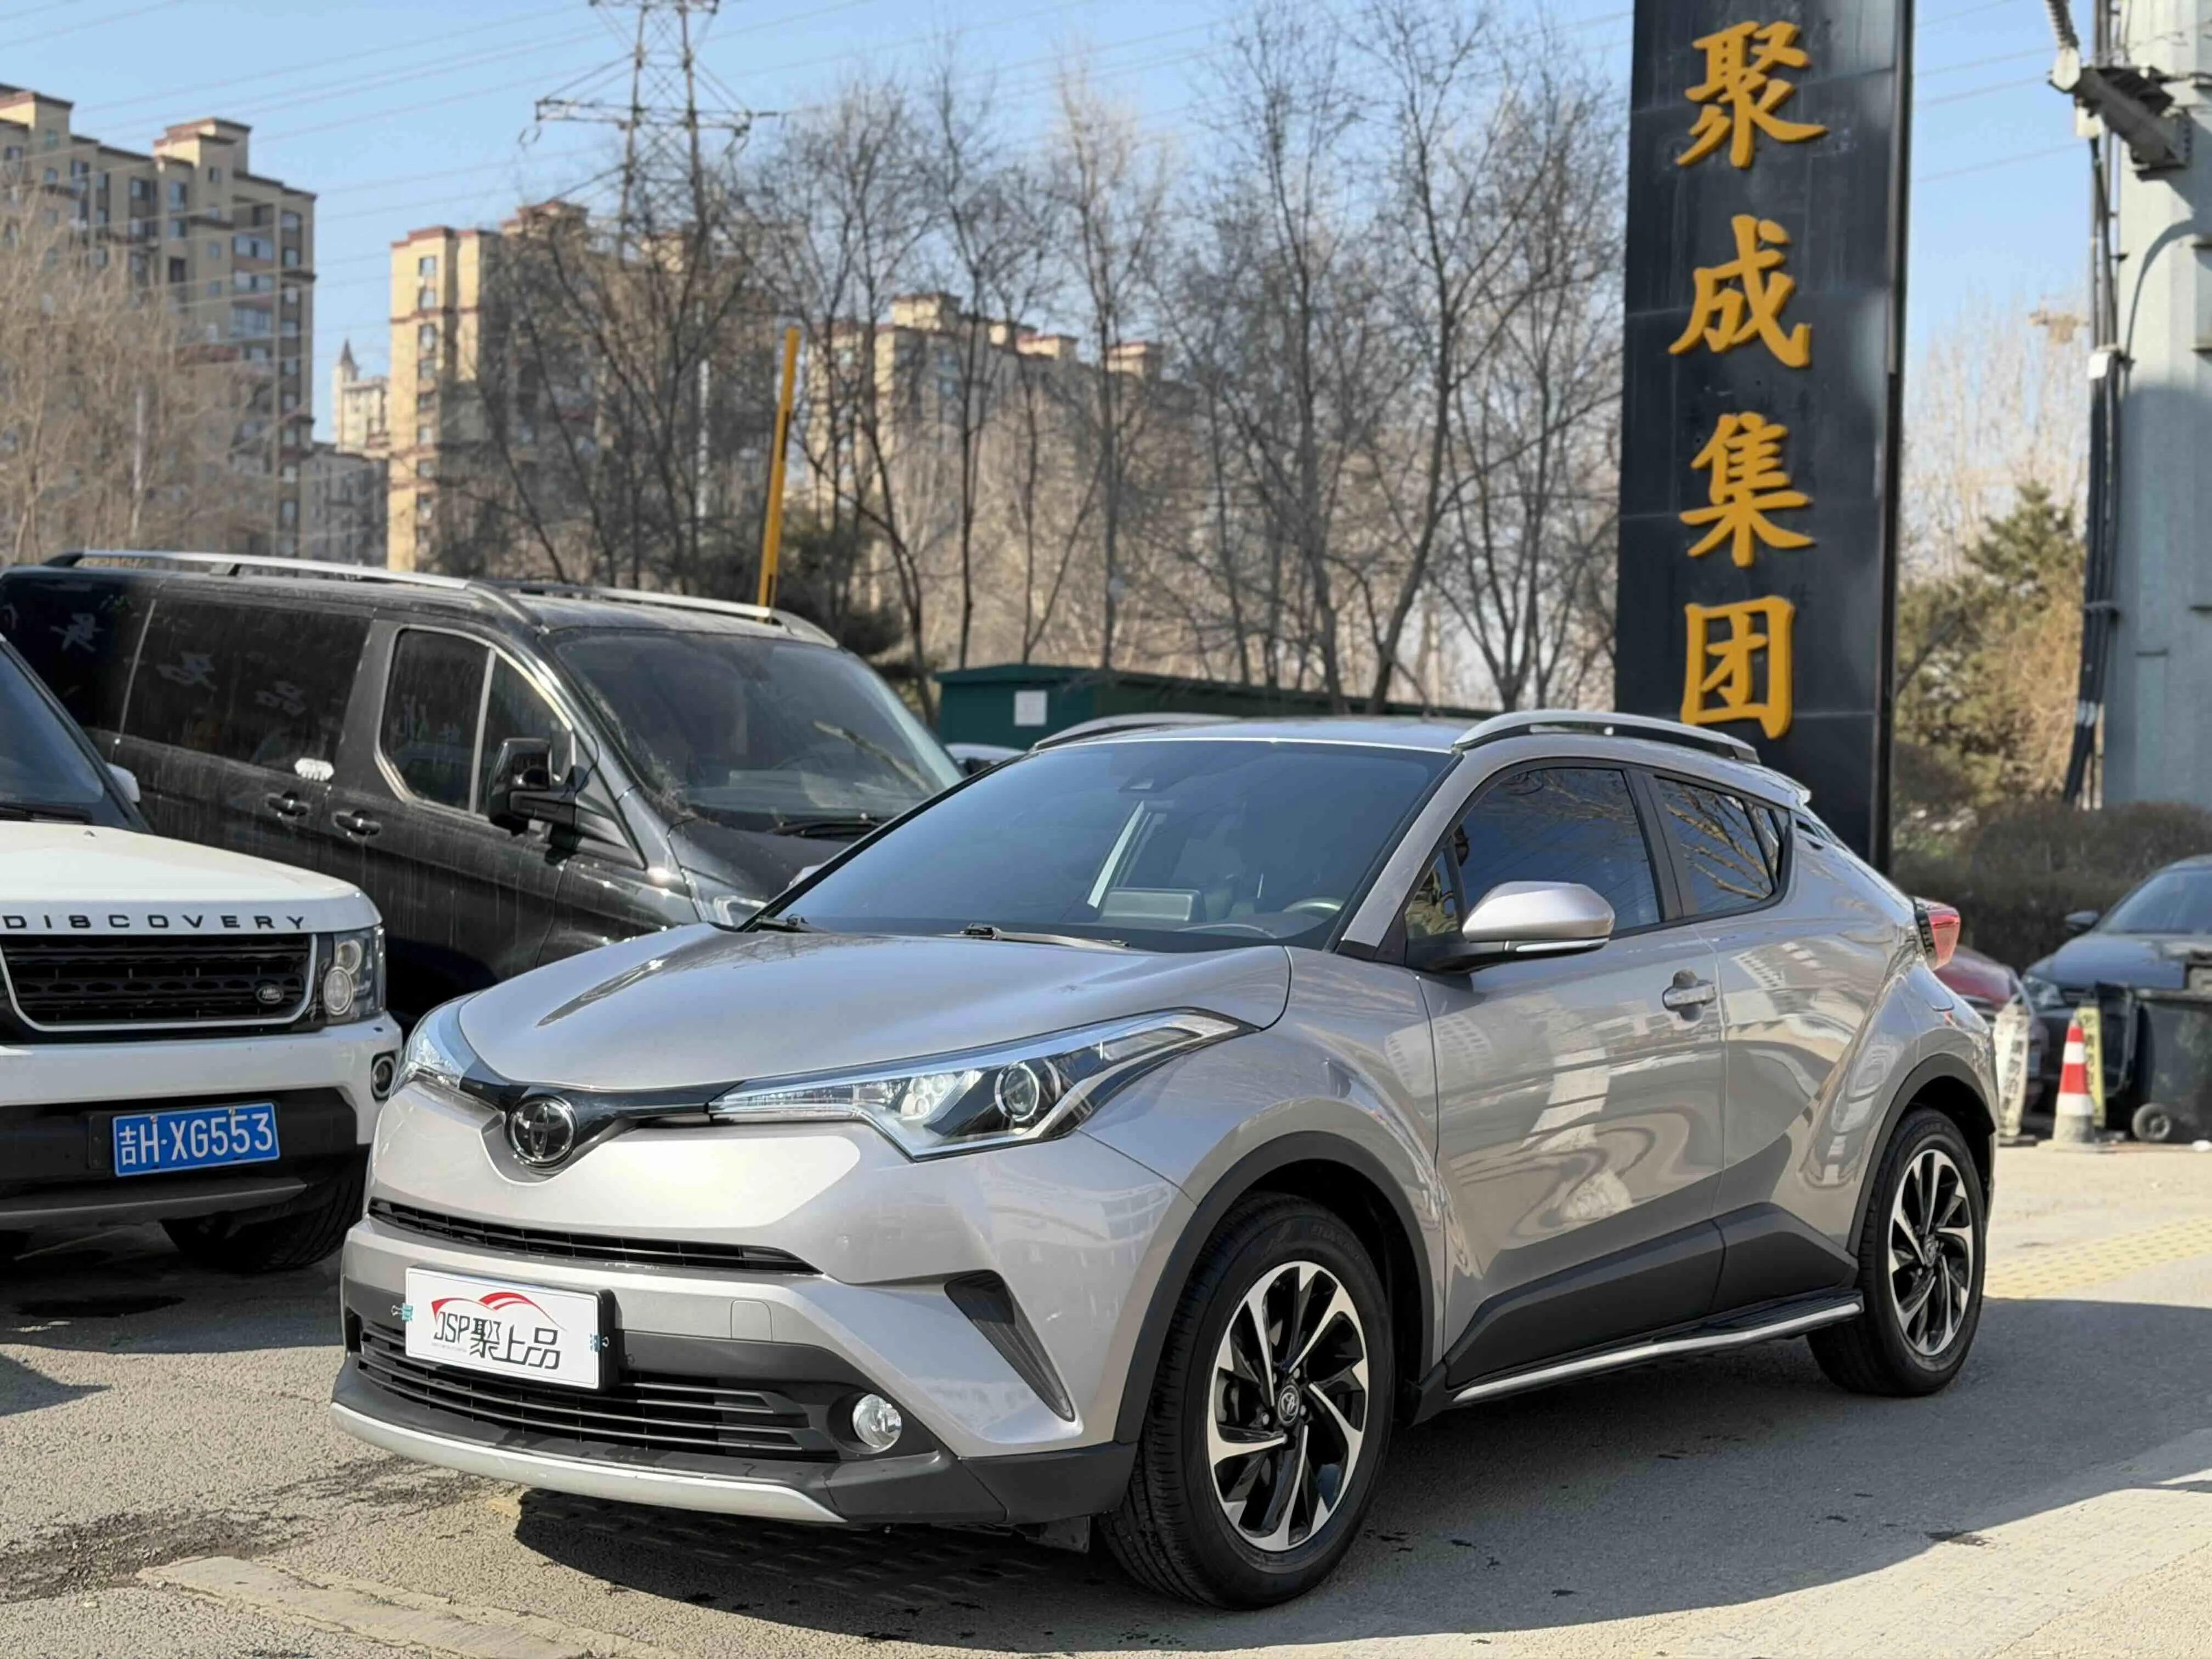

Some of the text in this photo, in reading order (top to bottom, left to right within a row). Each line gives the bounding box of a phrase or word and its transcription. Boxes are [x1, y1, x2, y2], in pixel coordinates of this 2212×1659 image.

[1669, 21, 1827, 738] 聚成集团
[2, 915, 304, 930] DISCOVERY
